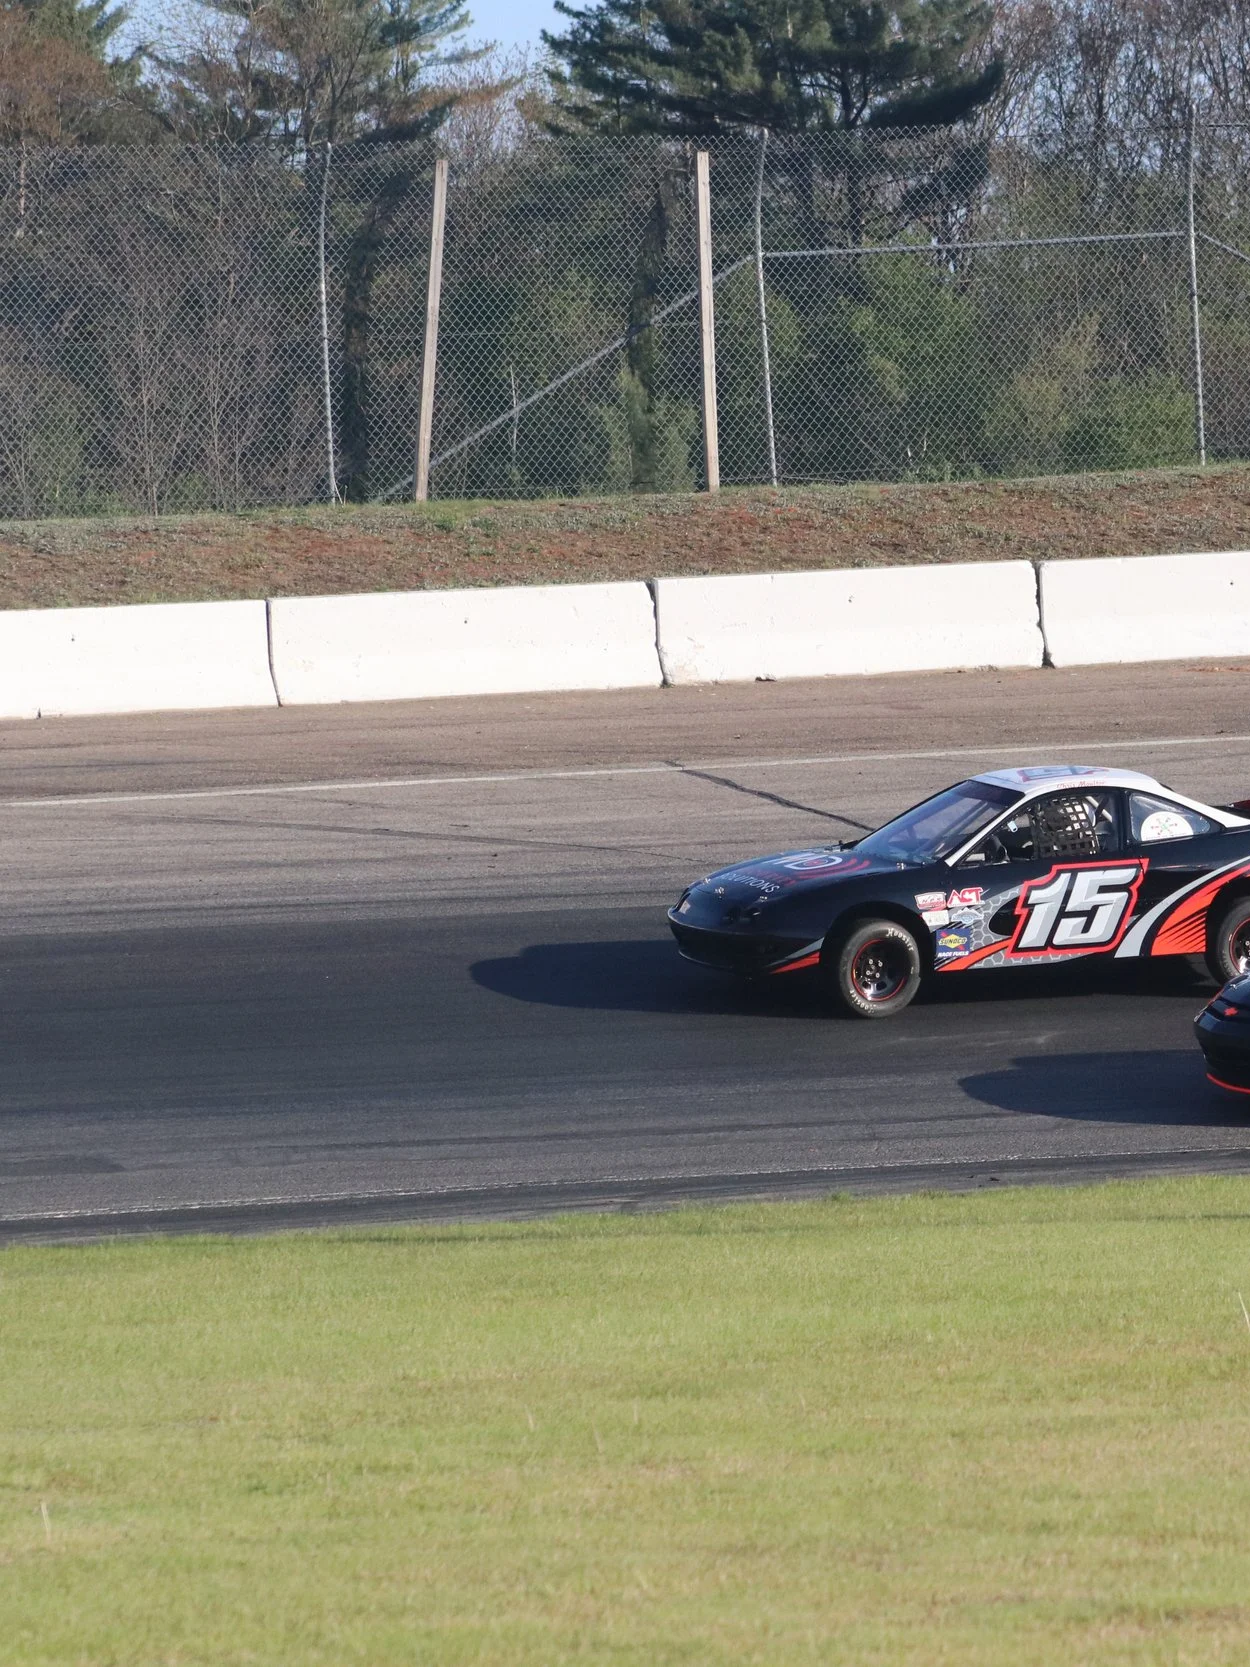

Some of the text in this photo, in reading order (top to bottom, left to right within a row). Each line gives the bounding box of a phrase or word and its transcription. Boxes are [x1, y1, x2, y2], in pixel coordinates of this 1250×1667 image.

[947, 887, 984, 908] ACT
[1017, 866, 1138, 949] 15
[886, 928, 914, 951] Hoosier
[939, 937, 967, 946] SUNOCO
